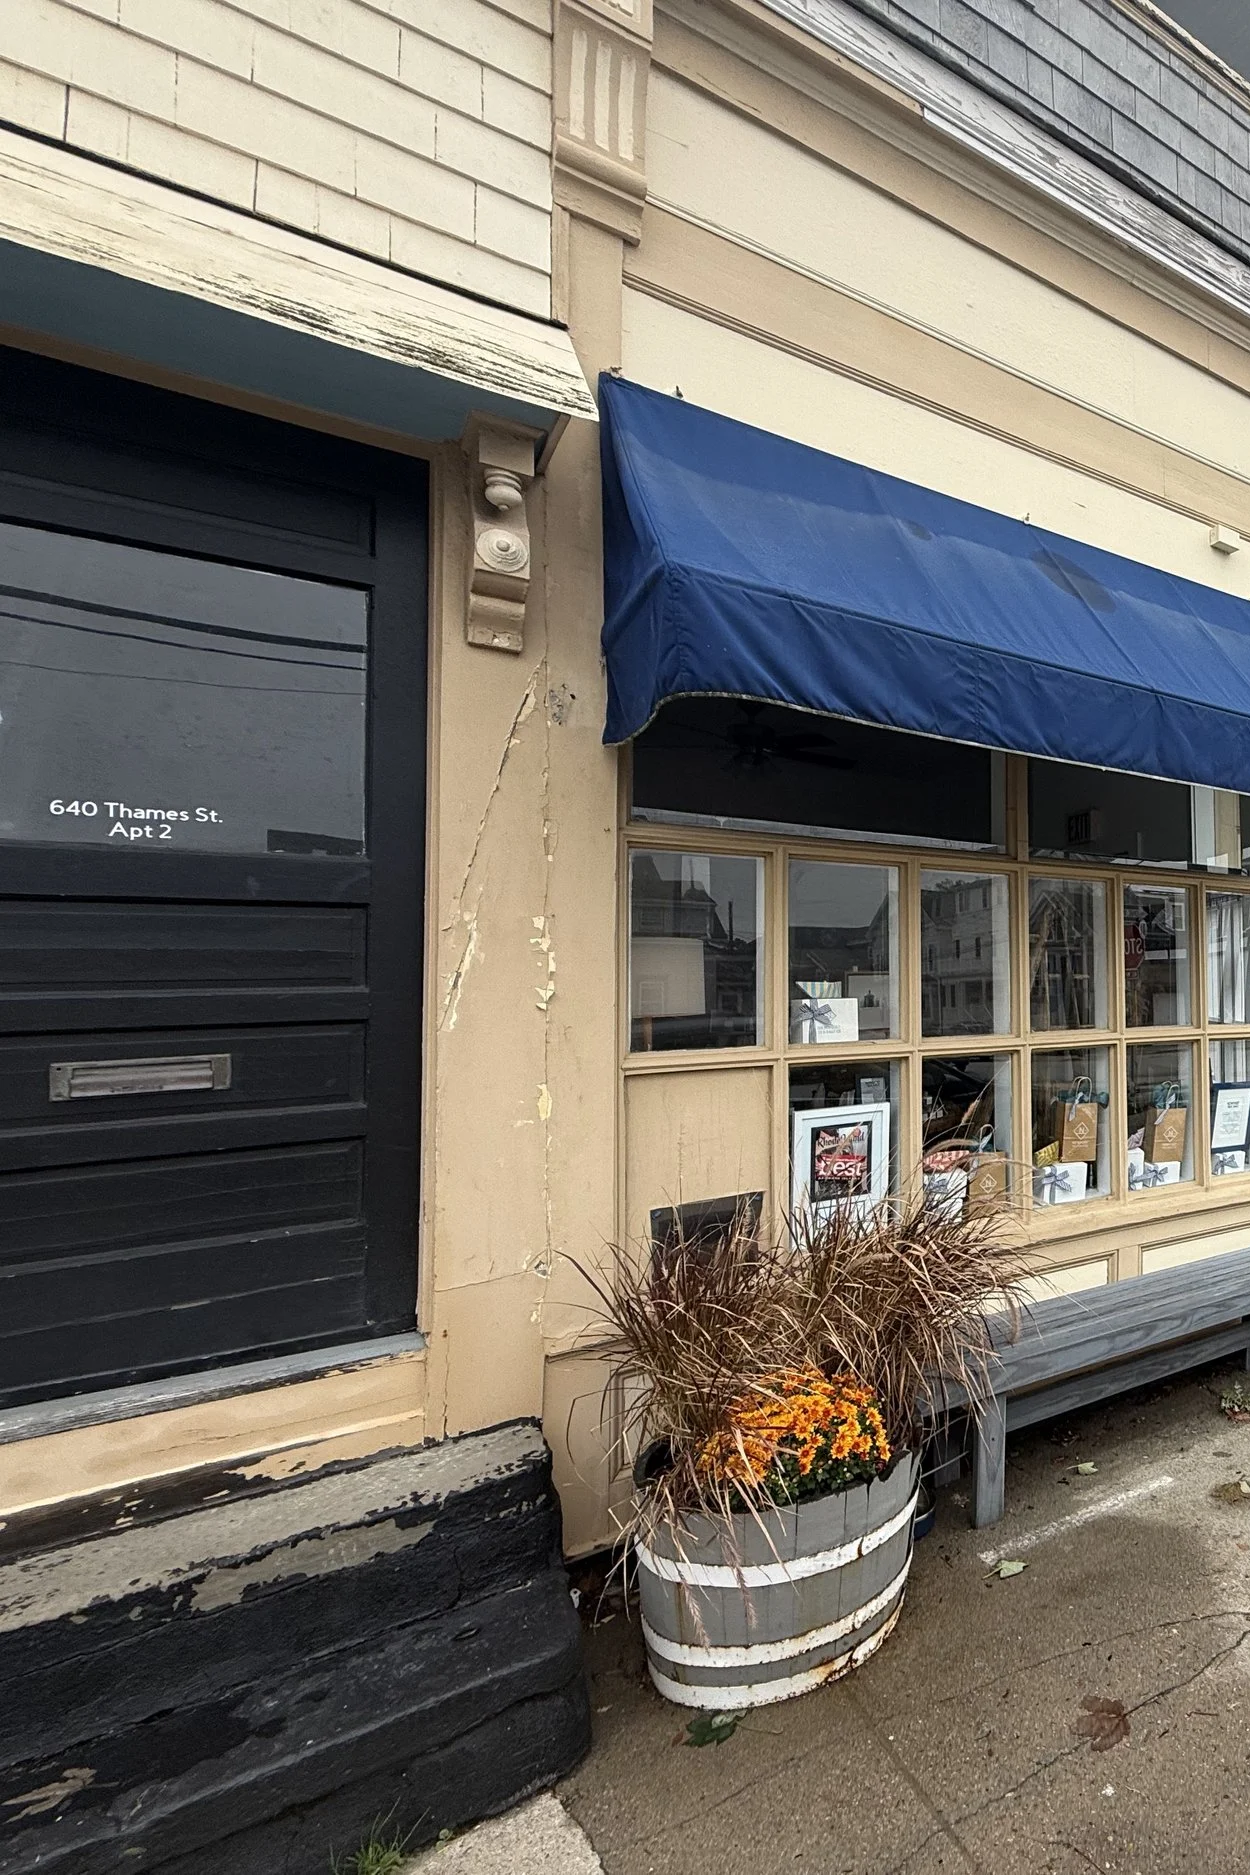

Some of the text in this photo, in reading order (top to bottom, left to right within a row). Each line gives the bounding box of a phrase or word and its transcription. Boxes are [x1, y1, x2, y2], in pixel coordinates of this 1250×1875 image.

[49, 800, 224, 823] 640 Thames St.
[108, 821, 172, 840] Apt 2
